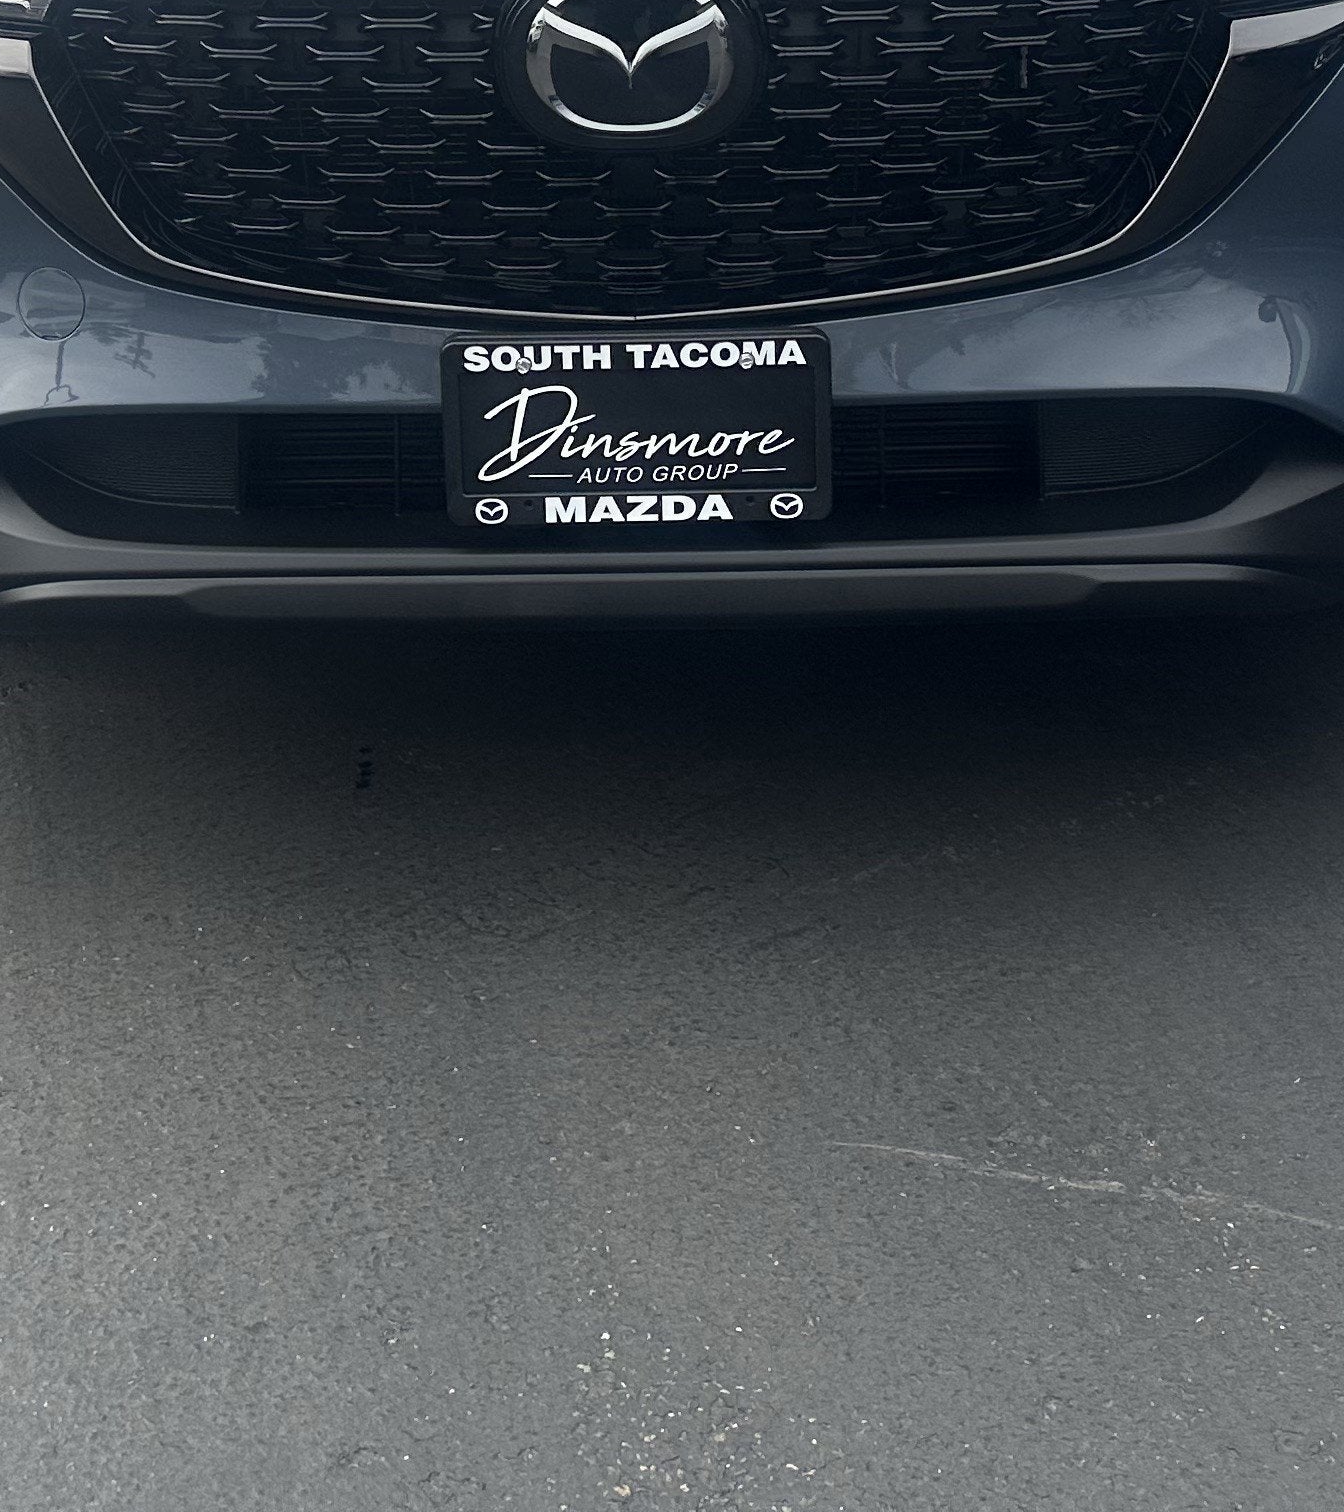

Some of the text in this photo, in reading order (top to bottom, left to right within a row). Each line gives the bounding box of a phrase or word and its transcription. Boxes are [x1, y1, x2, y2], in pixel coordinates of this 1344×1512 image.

[463, 339, 806, 373] SOUTH TACOMA
[478, 385, 795, 482] Dinsmore
[576, 463, 739, 484] AUTO GROUP
[545, 494, 734, 524] MAZDA
